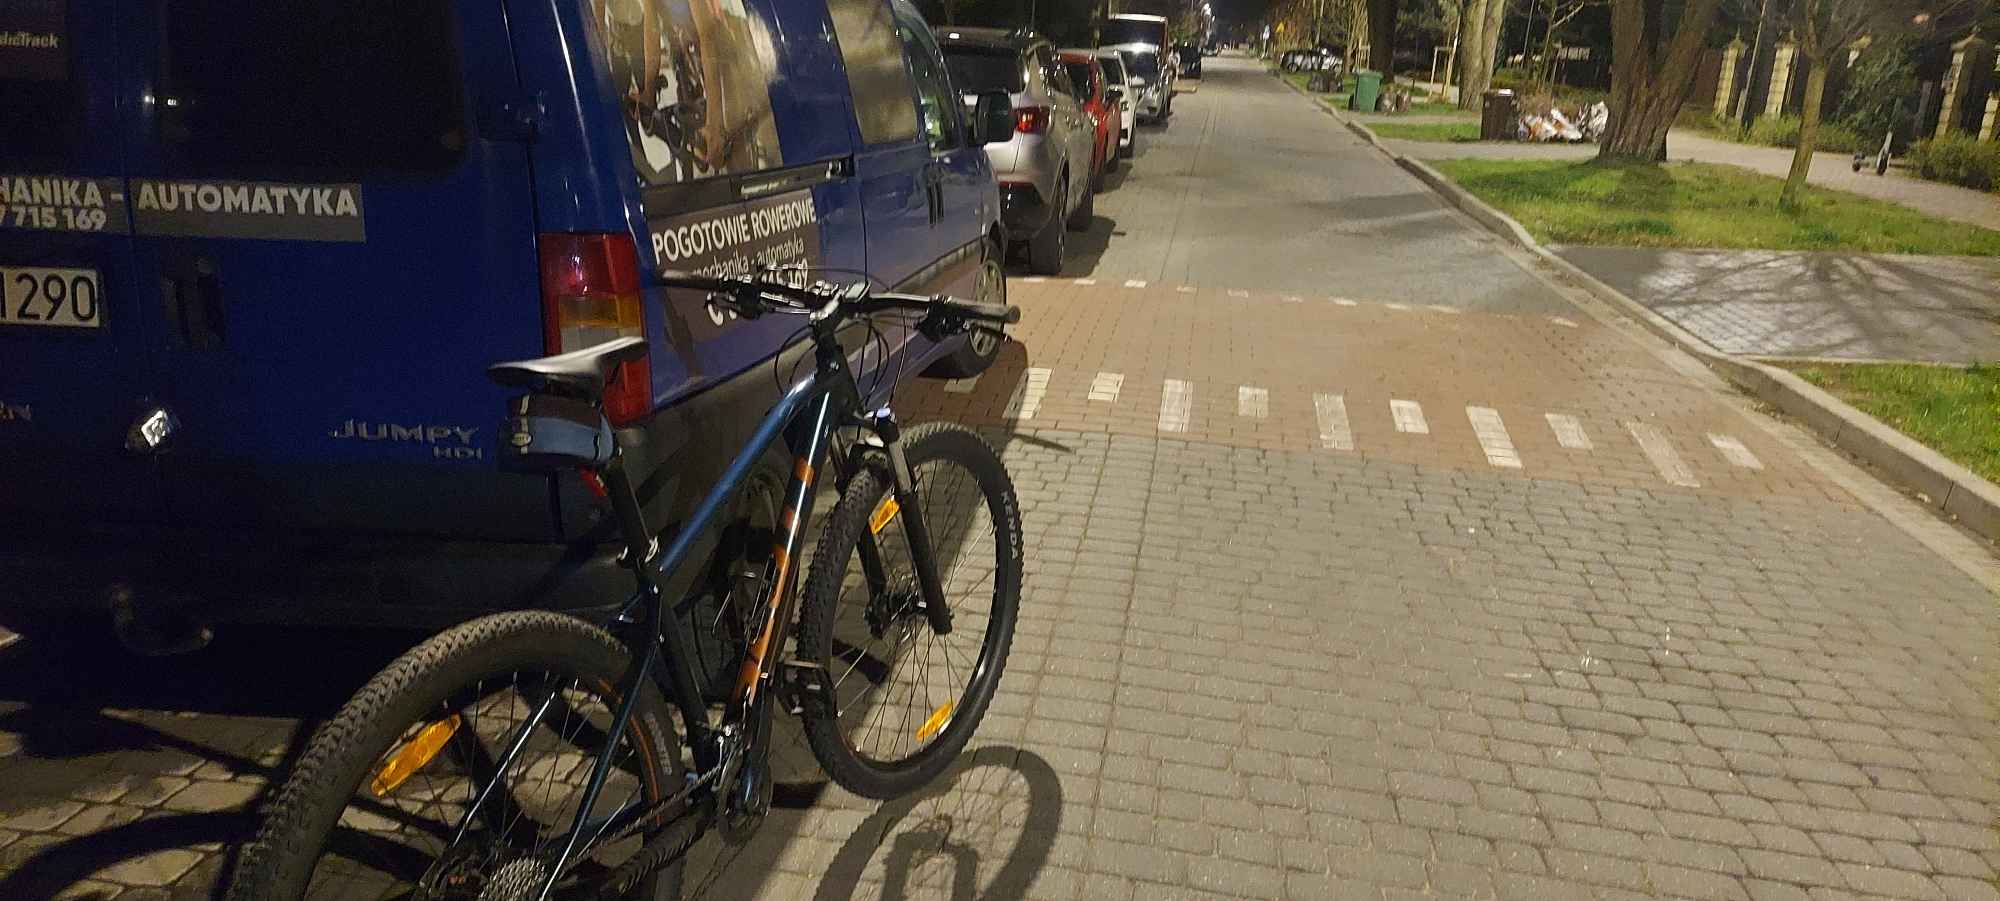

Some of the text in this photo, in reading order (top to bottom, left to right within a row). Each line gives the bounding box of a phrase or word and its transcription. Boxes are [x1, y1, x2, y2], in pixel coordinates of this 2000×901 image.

[138, 183, 358, 216] AUTOMATYKA
[12, 205, 57, 229] 715
[62, 208, 107, 232] 169
[652, 197, 817, 265] POGOTOWIE ROWEROWE
[329, 419, 480, 444] JUMPY
[433, 447, 483, 460] HDI
[1000, 490, 1019, 560] KENDA
